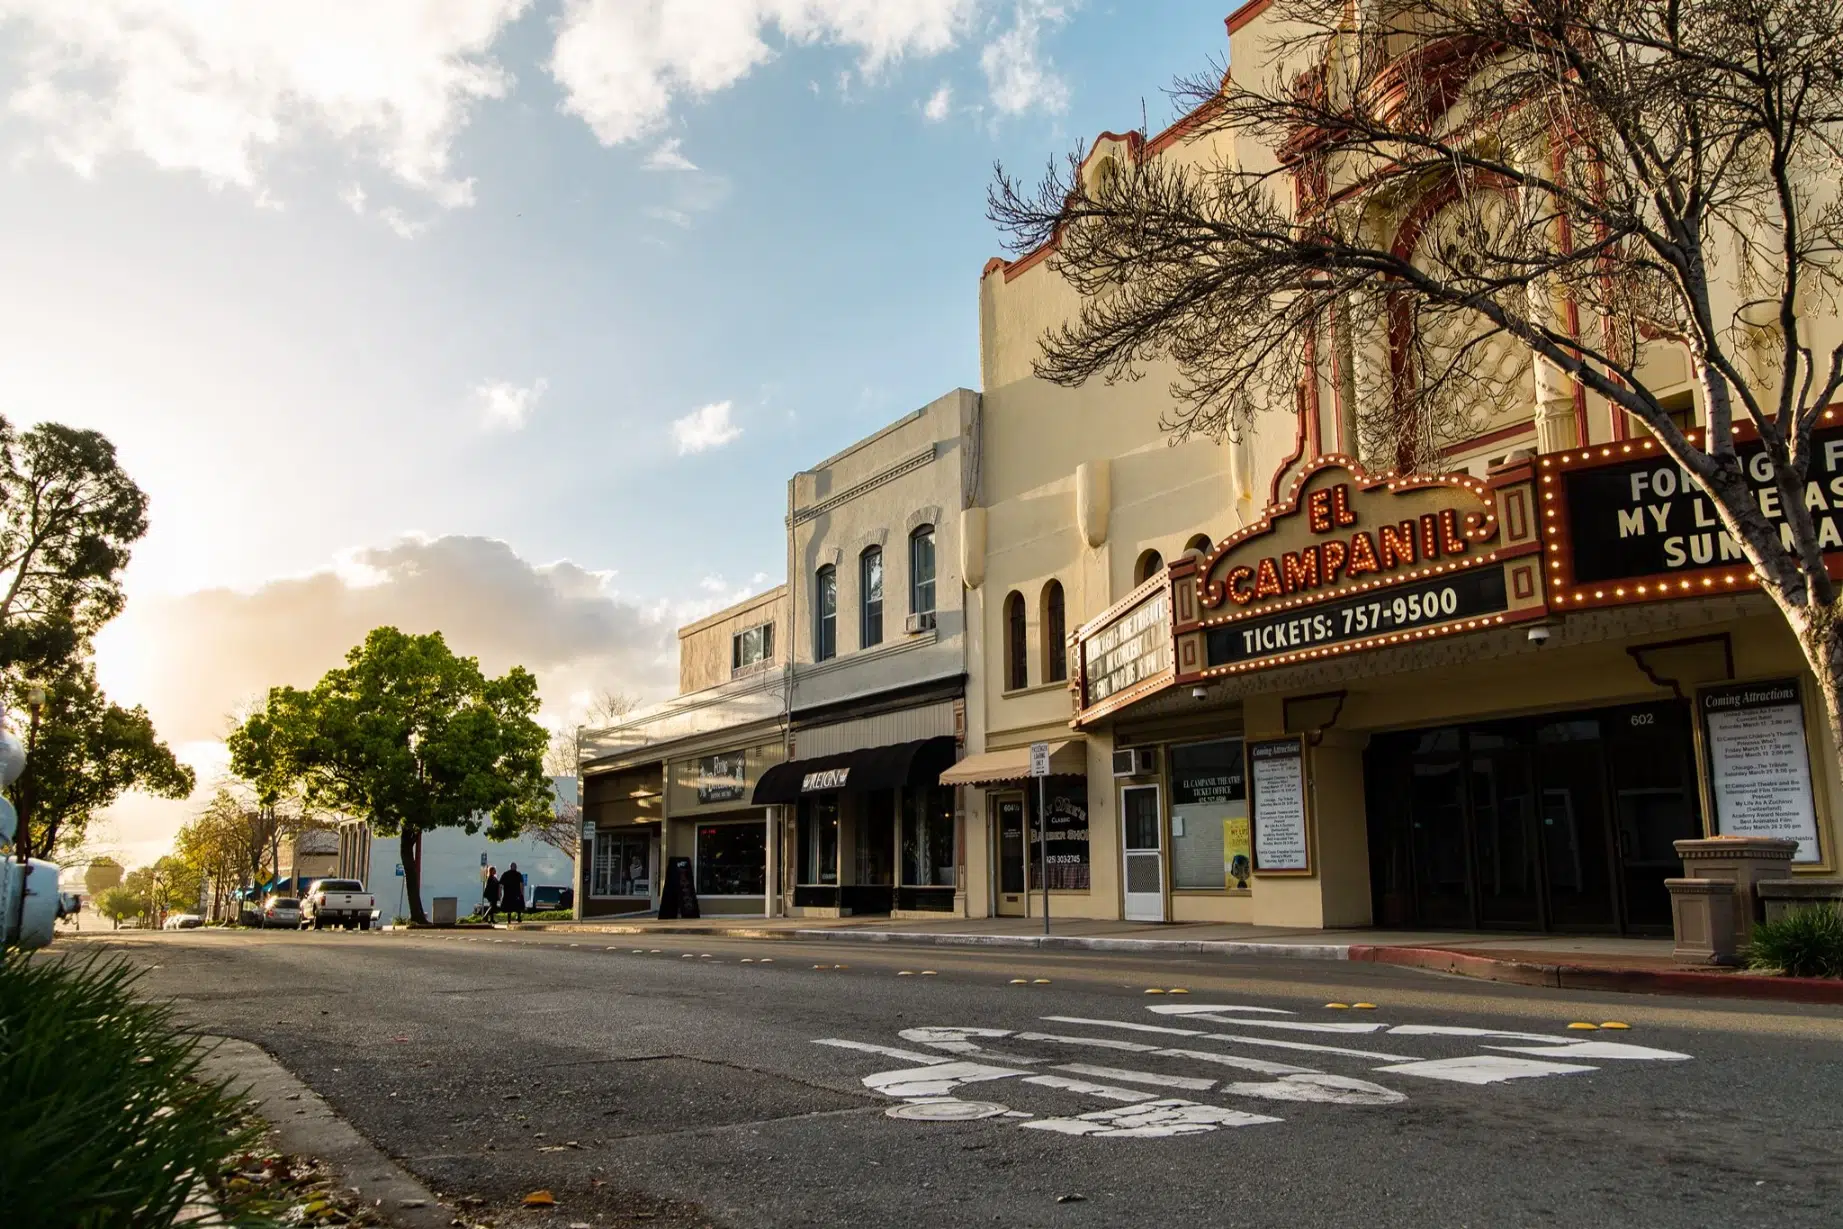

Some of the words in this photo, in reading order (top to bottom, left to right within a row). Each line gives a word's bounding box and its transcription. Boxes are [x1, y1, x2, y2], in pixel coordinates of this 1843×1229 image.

[1630, 451, 1775, 502] FORG
[1308, 483, 1357, 534] EL
[1618, 501, 1672, 539] MY
[1693, 486, 1782, 528] LE
[1226, 508, 1469, 605] CAMPANIL
[1663, 529, 1742, 568] SUN
[1243, 614, 1333, 654] TICKETS:
[1342, 587, 1458, 635] 757-9500
[1631, 713, 1654, 726] 602
[1705, 693, 1740, 708] Coming
[1742, 687, 1794, 704] Attractions
[810, 770, 840, 790] REIGN
